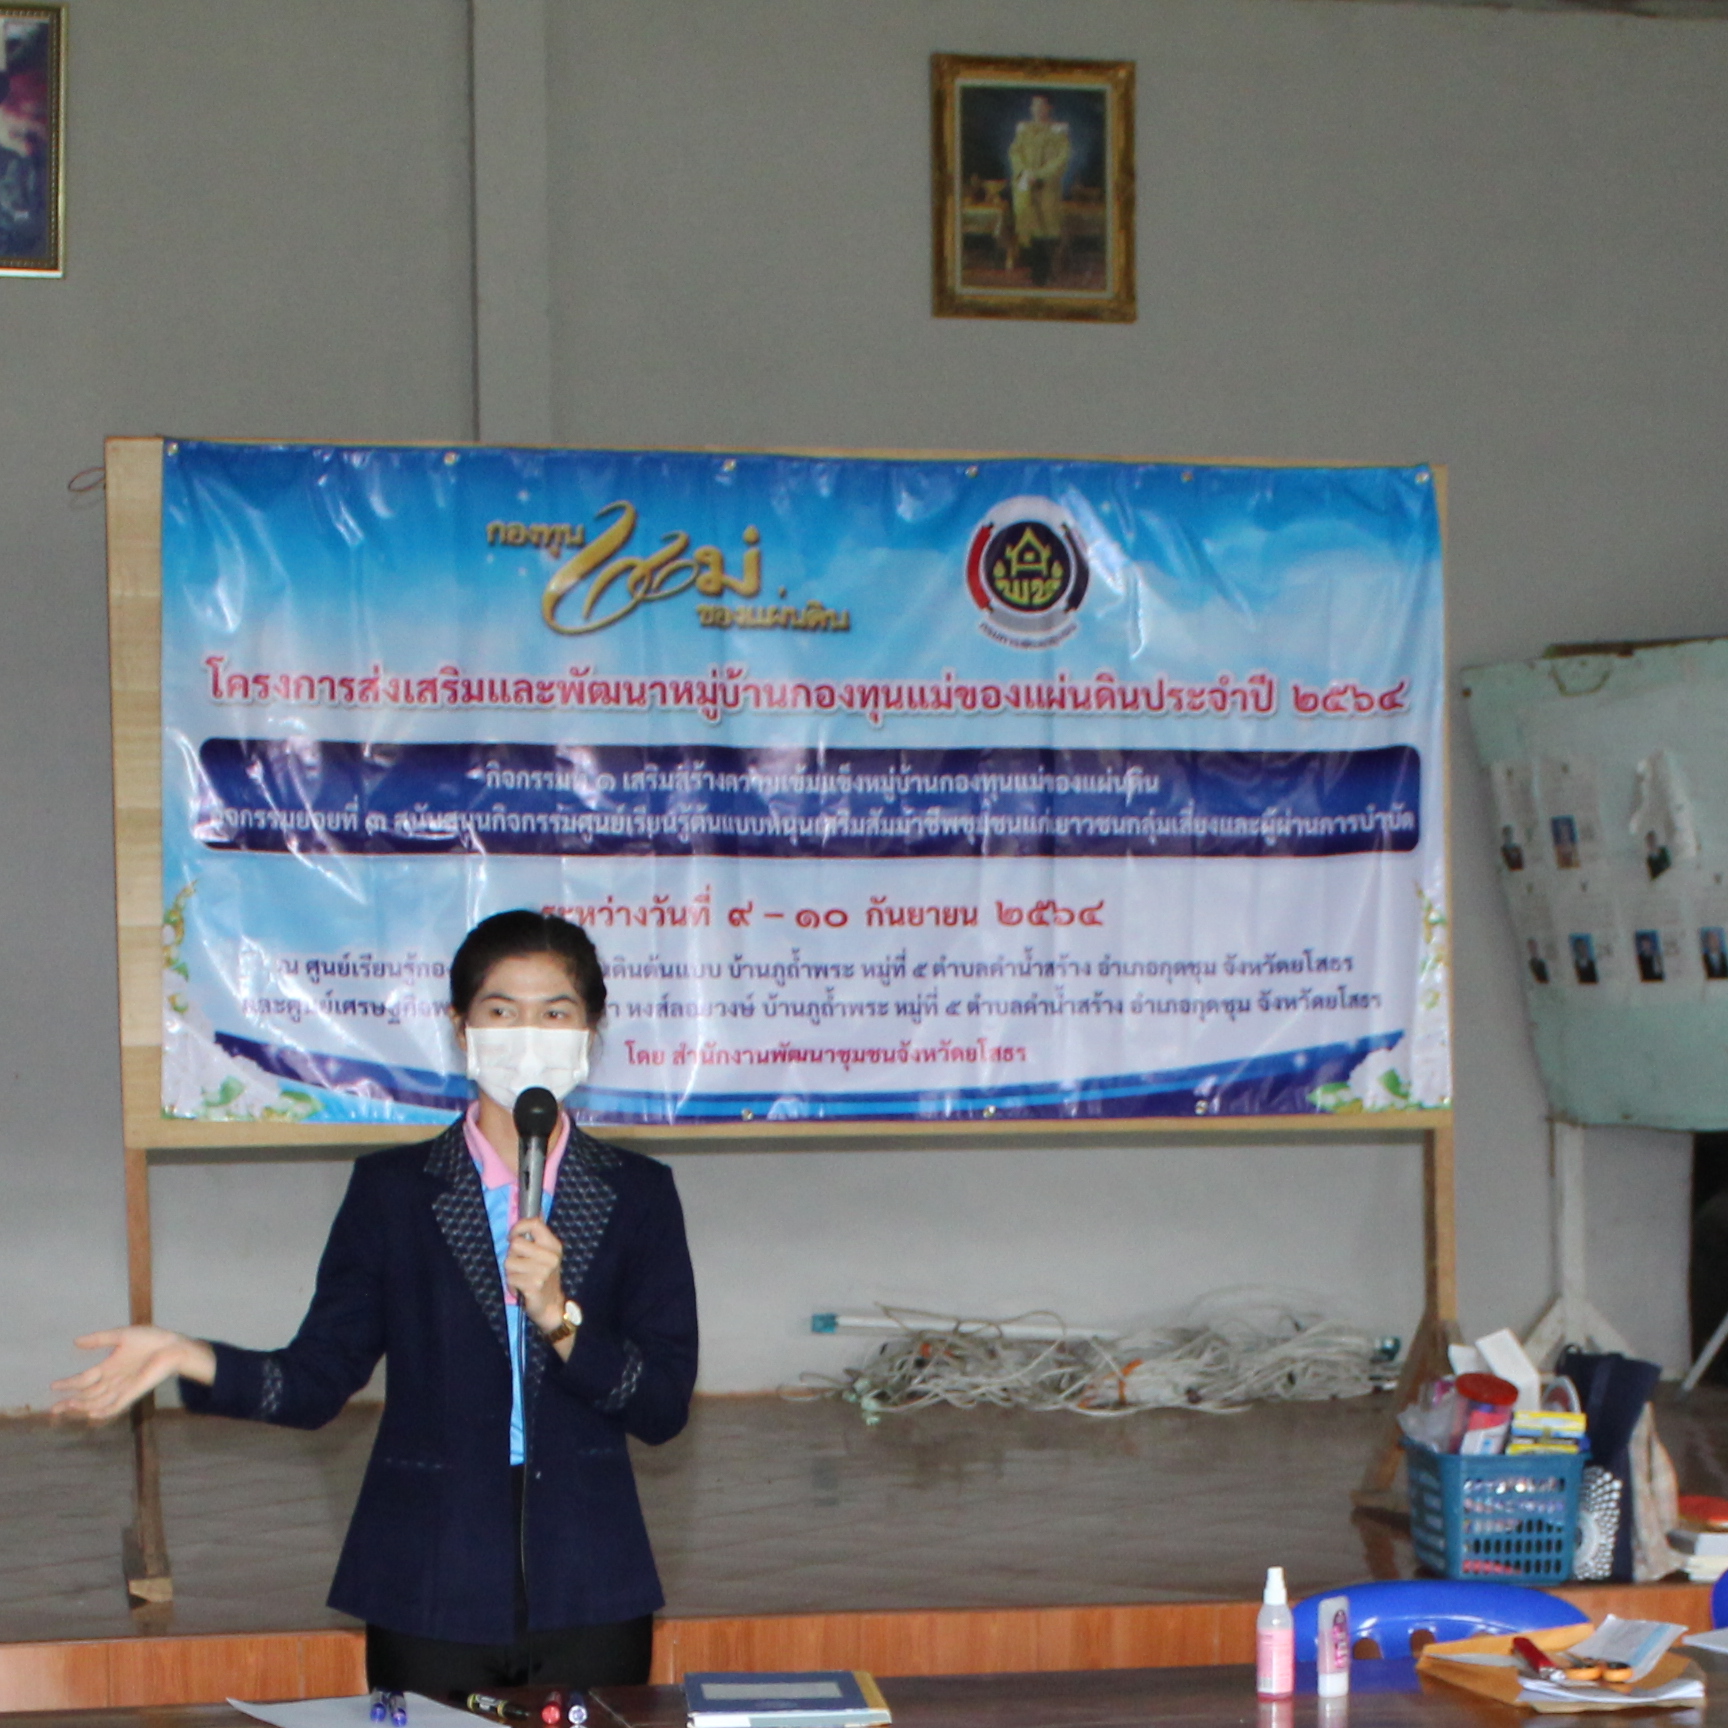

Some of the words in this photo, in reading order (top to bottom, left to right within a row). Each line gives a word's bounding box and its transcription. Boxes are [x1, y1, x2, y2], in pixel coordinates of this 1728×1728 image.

[1291, 676, 1409, 714] ๒๕๖๔
[726, 900, 753, 928] ๙
[794, 906, 848, 929] ๑๐
[864, 894, 979, 928] กันยายน
[995, 898, 1105, 928] ๒๕๖๔
[861, 947, 907, 987] หมู่ที่
[624, 1040, 666, 1065] โดย
